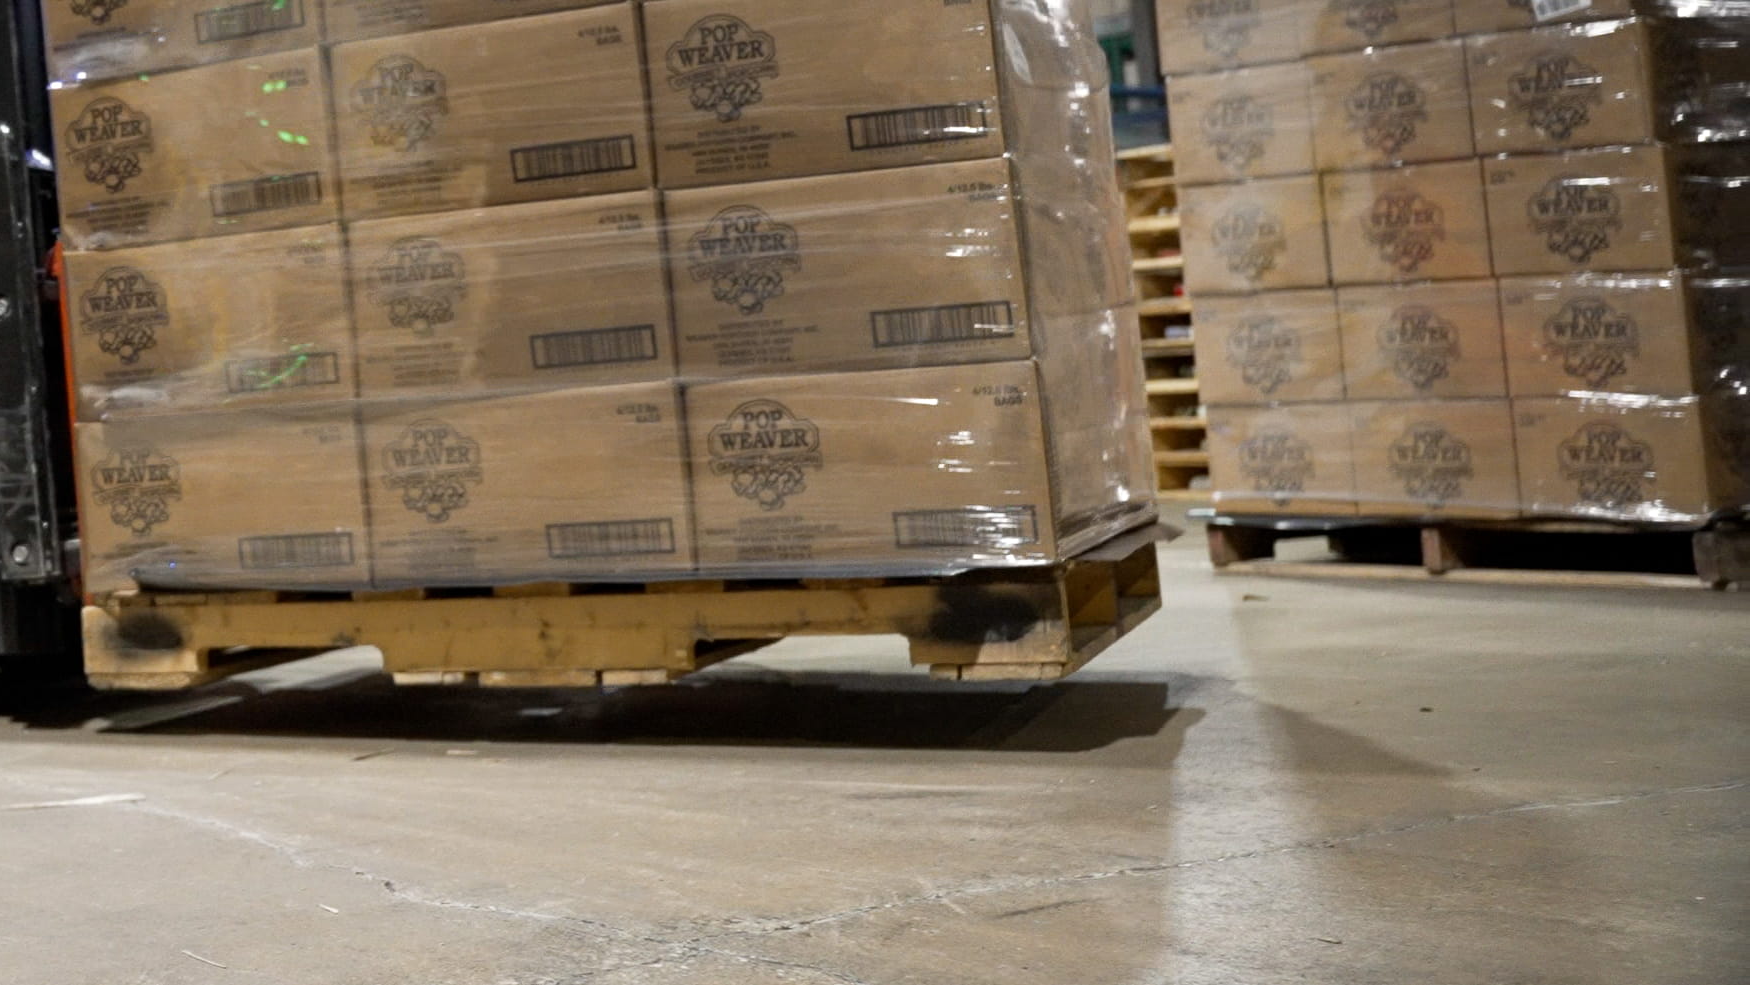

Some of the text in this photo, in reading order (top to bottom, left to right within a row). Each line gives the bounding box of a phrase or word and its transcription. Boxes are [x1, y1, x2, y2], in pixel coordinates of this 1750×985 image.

[698, 24, 739, 45] POP
[678, 40, 764, 67] WEAVER
[90, 105, 123, 124] POP
[74, 119, 143, 144] WEAVER
[1537, 196, 1610, 216] WEAVER
[720, 215, 761, 235] POP
[699, 233, 787, 258] WEAVER
[105, 275, 138, 293] POP
[88, 291, 157, 312] WEAVER
[1571, 306, 1607, 324] POP
[1553, 321, 1628, 340] WEAVER
[742, 409, 783, 429] POP
[412, 428, 448, 447] POP
[720, 428, 808, 451] WEAVER
[1586, 431, 1620, 448] POP
[393, 447, 470, 467] WEAVER
[1394, 445, 1463, 463] WEAVER
[1567, 446, 1644, 464] WEAVER
[101, 464, 171, 485] WEAVER
